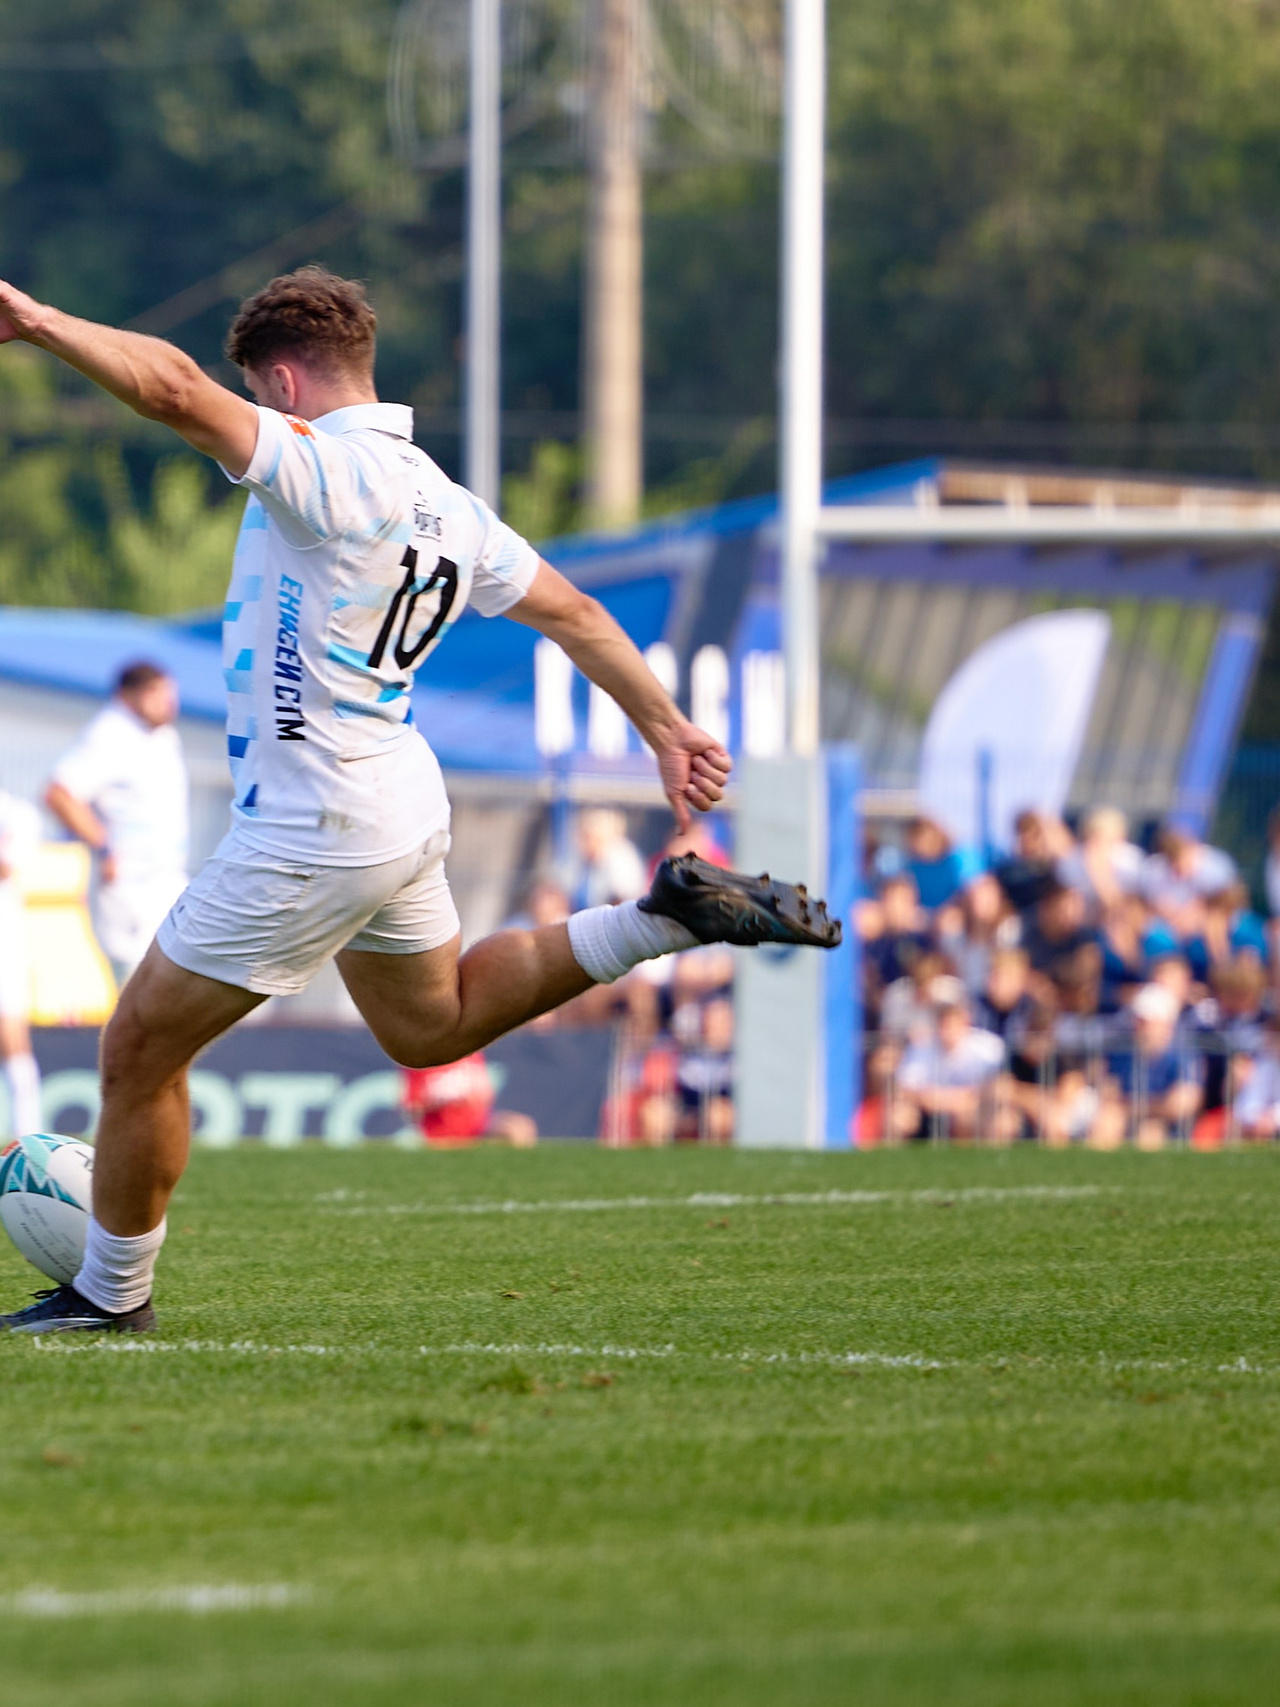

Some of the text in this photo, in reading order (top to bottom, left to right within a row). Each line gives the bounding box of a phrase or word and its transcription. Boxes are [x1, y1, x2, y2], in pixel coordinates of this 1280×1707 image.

[273, 573, 306, 742] ЕНИСЕЙ СТМ
[366, 544, 459, 672] 10
